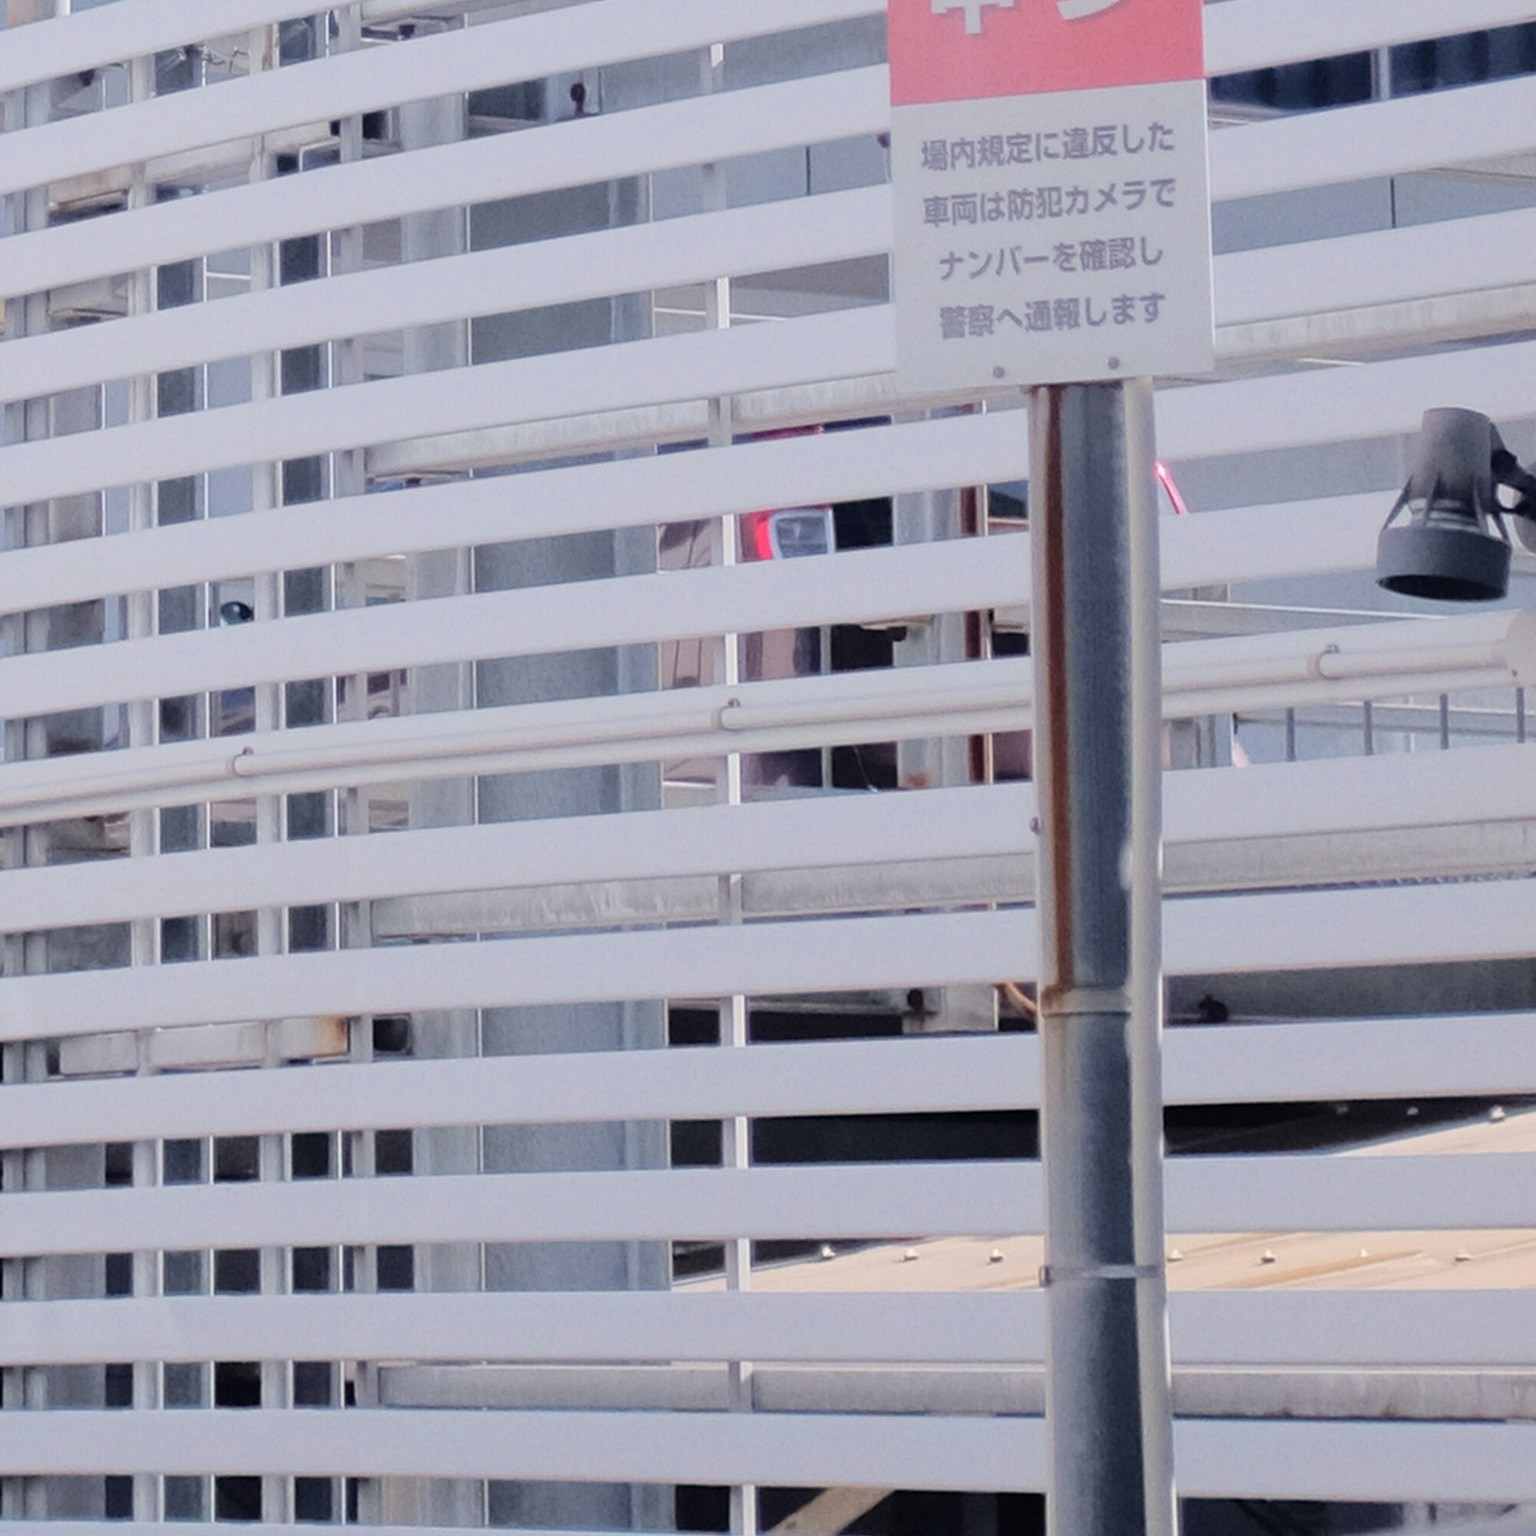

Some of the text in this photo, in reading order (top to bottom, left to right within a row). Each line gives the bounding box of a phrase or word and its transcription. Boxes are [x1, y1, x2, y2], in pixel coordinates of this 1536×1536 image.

[921, 121, 1176, 172] 場内規定に違反した
[922, 177, 1177, 228] 車両は防犯カメラで
[939, 235, 1164, 281] ナンバーを確認し
[939, 291, 1166, 340] 警察へ通報します
